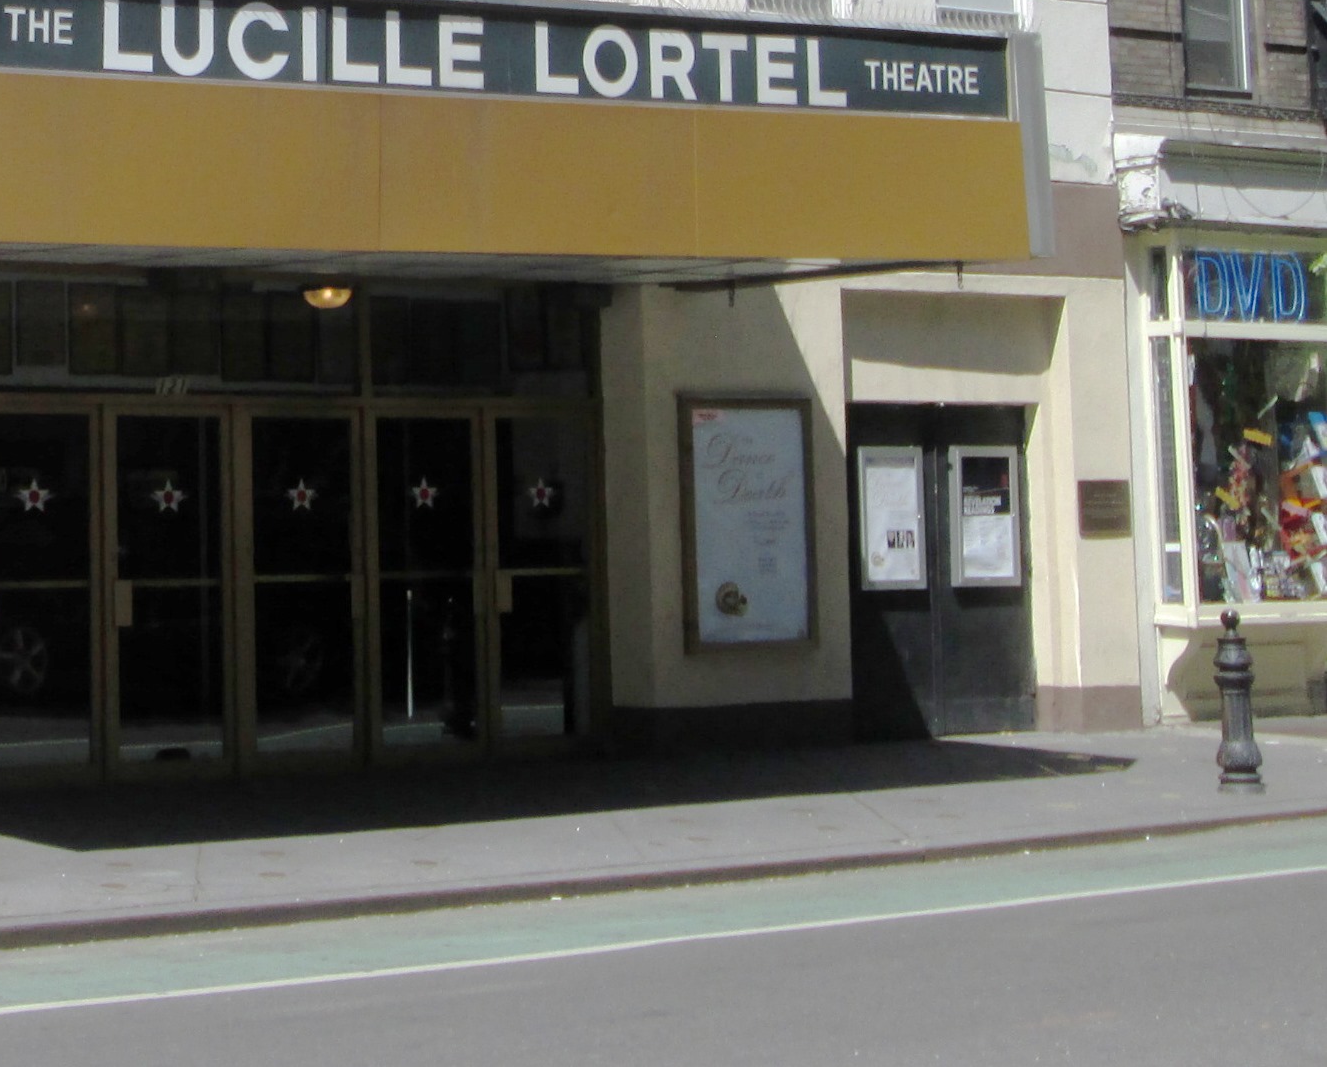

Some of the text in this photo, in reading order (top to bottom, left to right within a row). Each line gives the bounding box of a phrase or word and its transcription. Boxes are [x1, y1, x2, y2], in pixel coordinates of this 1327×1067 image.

[3, 5, 74, 46] THE
[535, 21, 848, 107] LORTEL
[864, 60, 980, 95] THEATRE
[1195, 249, 1308, 323] DVD
